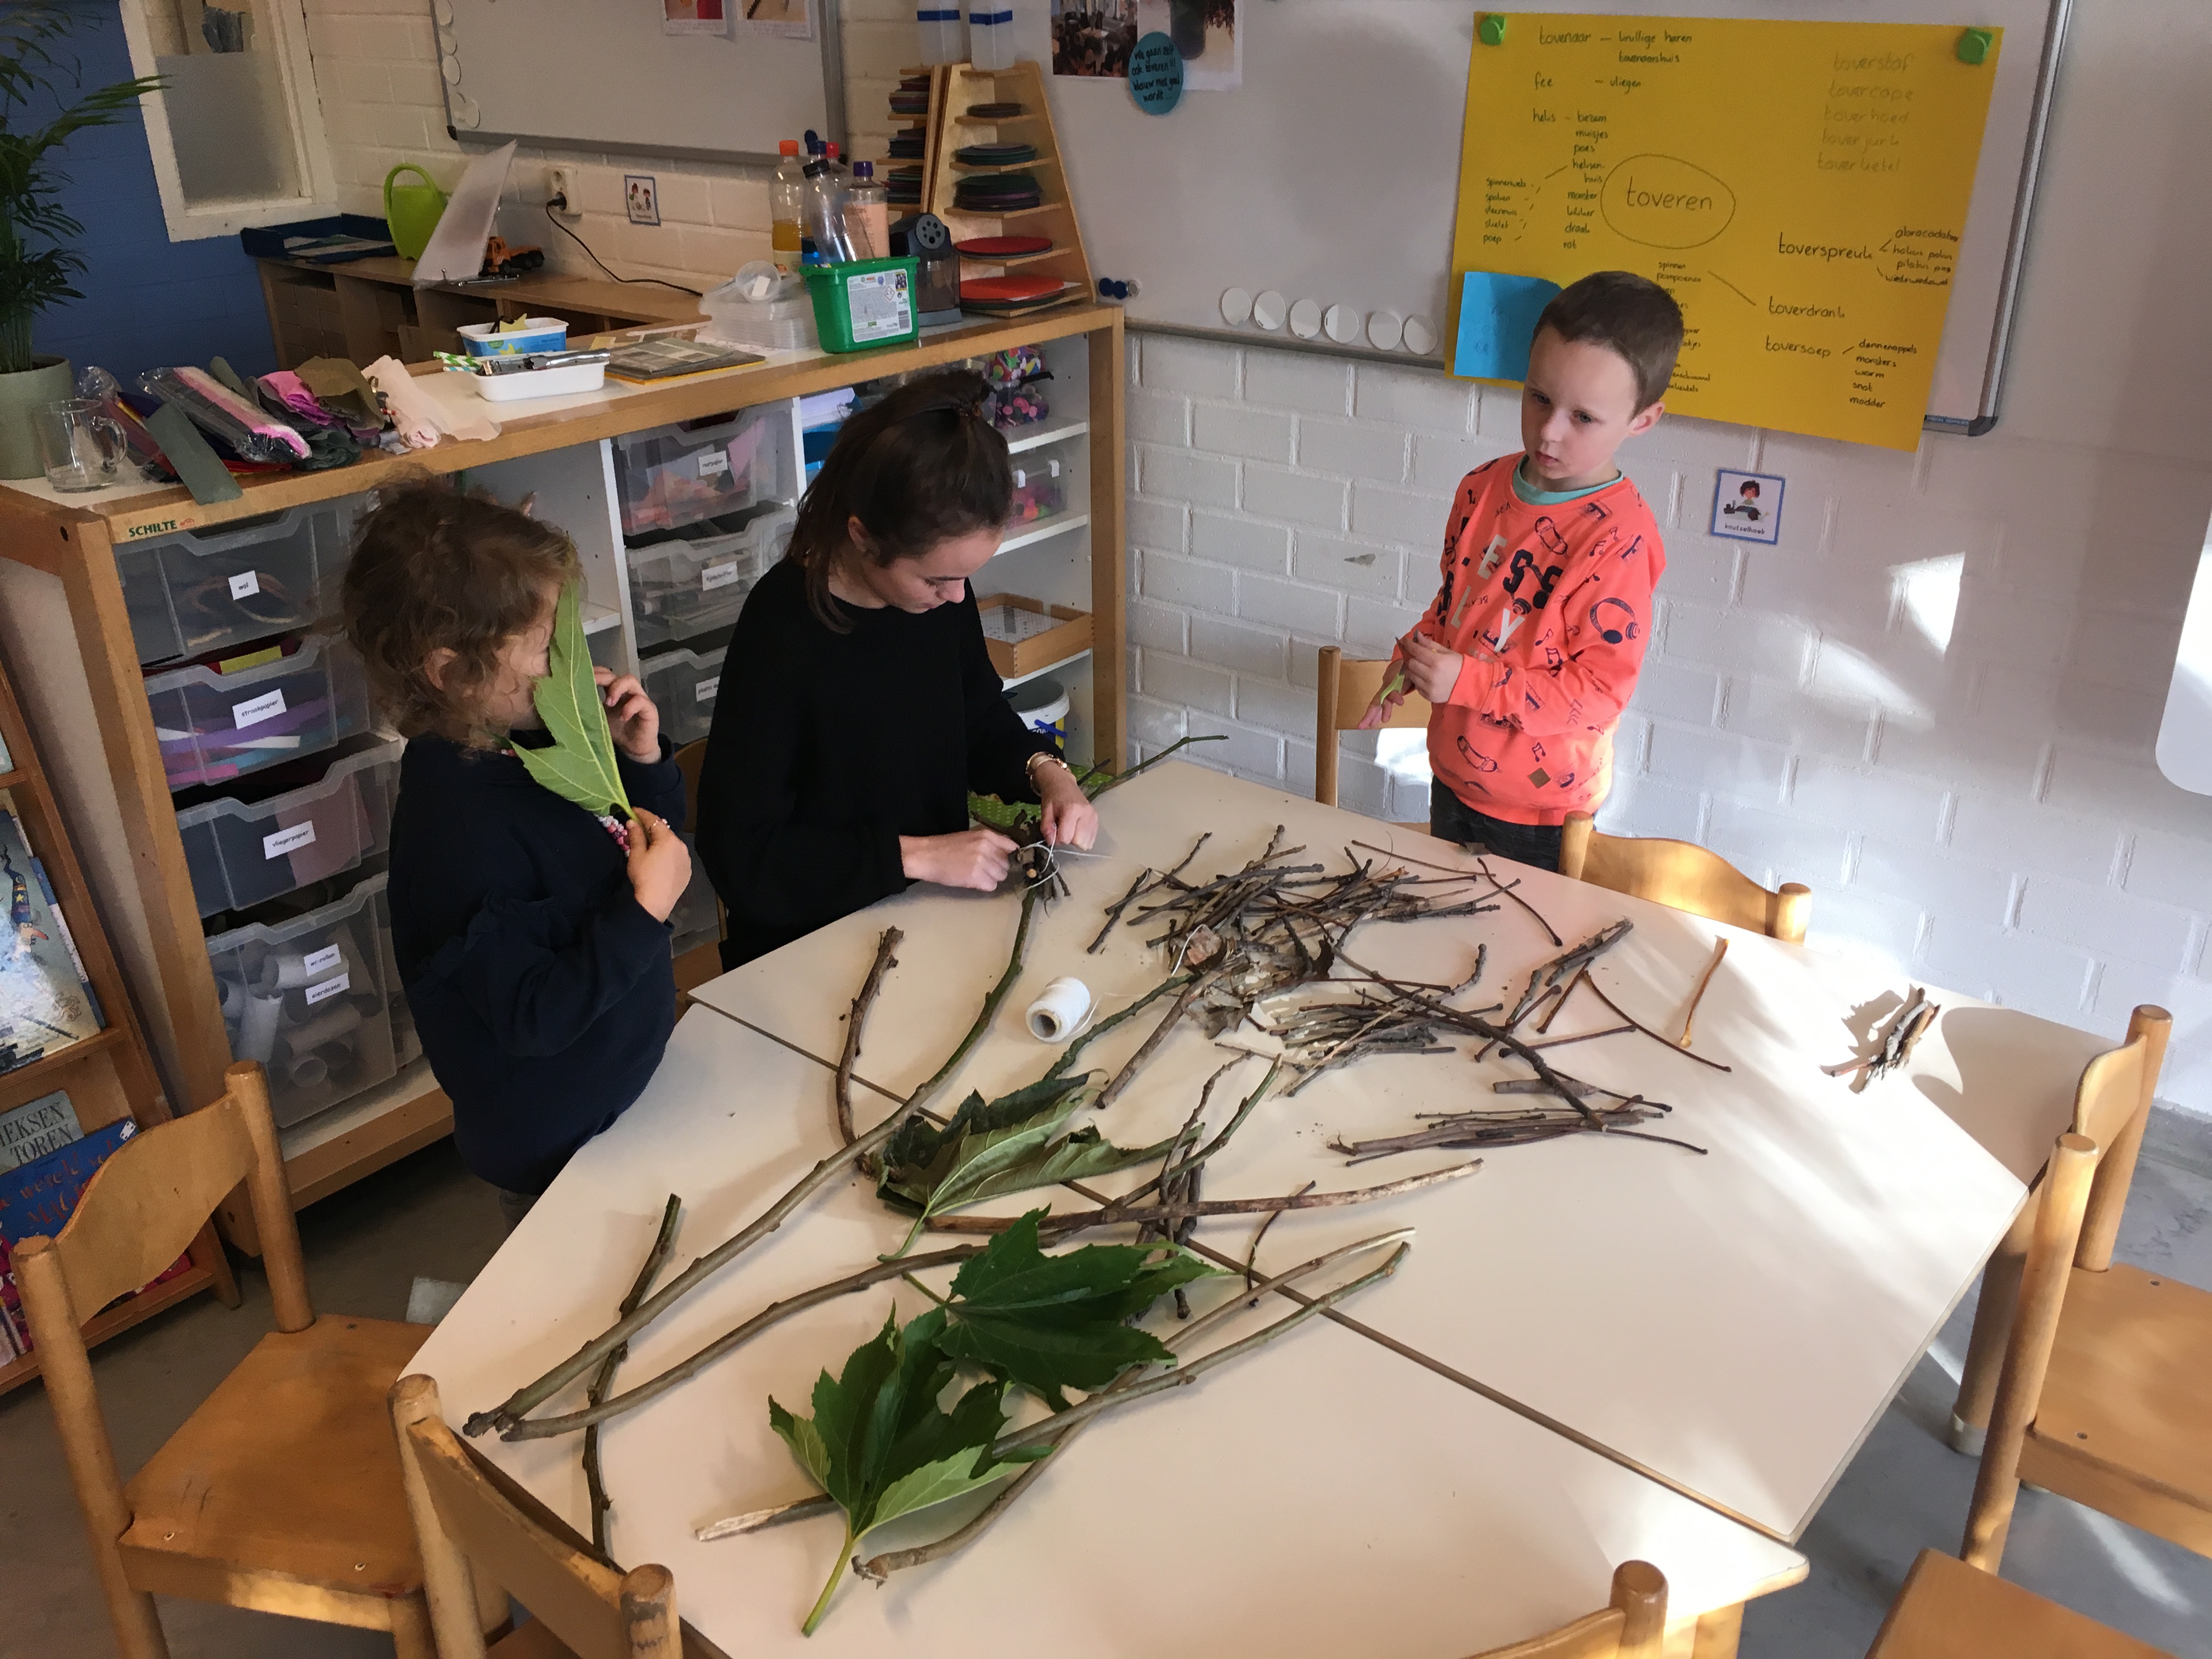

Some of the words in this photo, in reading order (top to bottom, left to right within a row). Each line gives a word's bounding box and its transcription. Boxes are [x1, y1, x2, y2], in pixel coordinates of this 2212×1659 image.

[1539, 25, 1590, 45] tovenaar
[1534, 72, 1553, 89] fee
[1610, 76, 1641, 94] vliegen
[1573, 144, 1595, 156] poes
[1627, 175, 1712, 211] toveren
[1779, 232, 1872, 262] toverspreuk
[1769, 295, 1845, 318] toverdrank
[1765, 335, 1831, 359] toversoep
[128, 520, 177, 537] SCHILTE
[1724, 522, 1765, 535] knutselhoek
[238, 582, 249, 590] wol
[312, 983, 341, 998] eierdozen
[10, 1124, 74, 1165] TOREN
